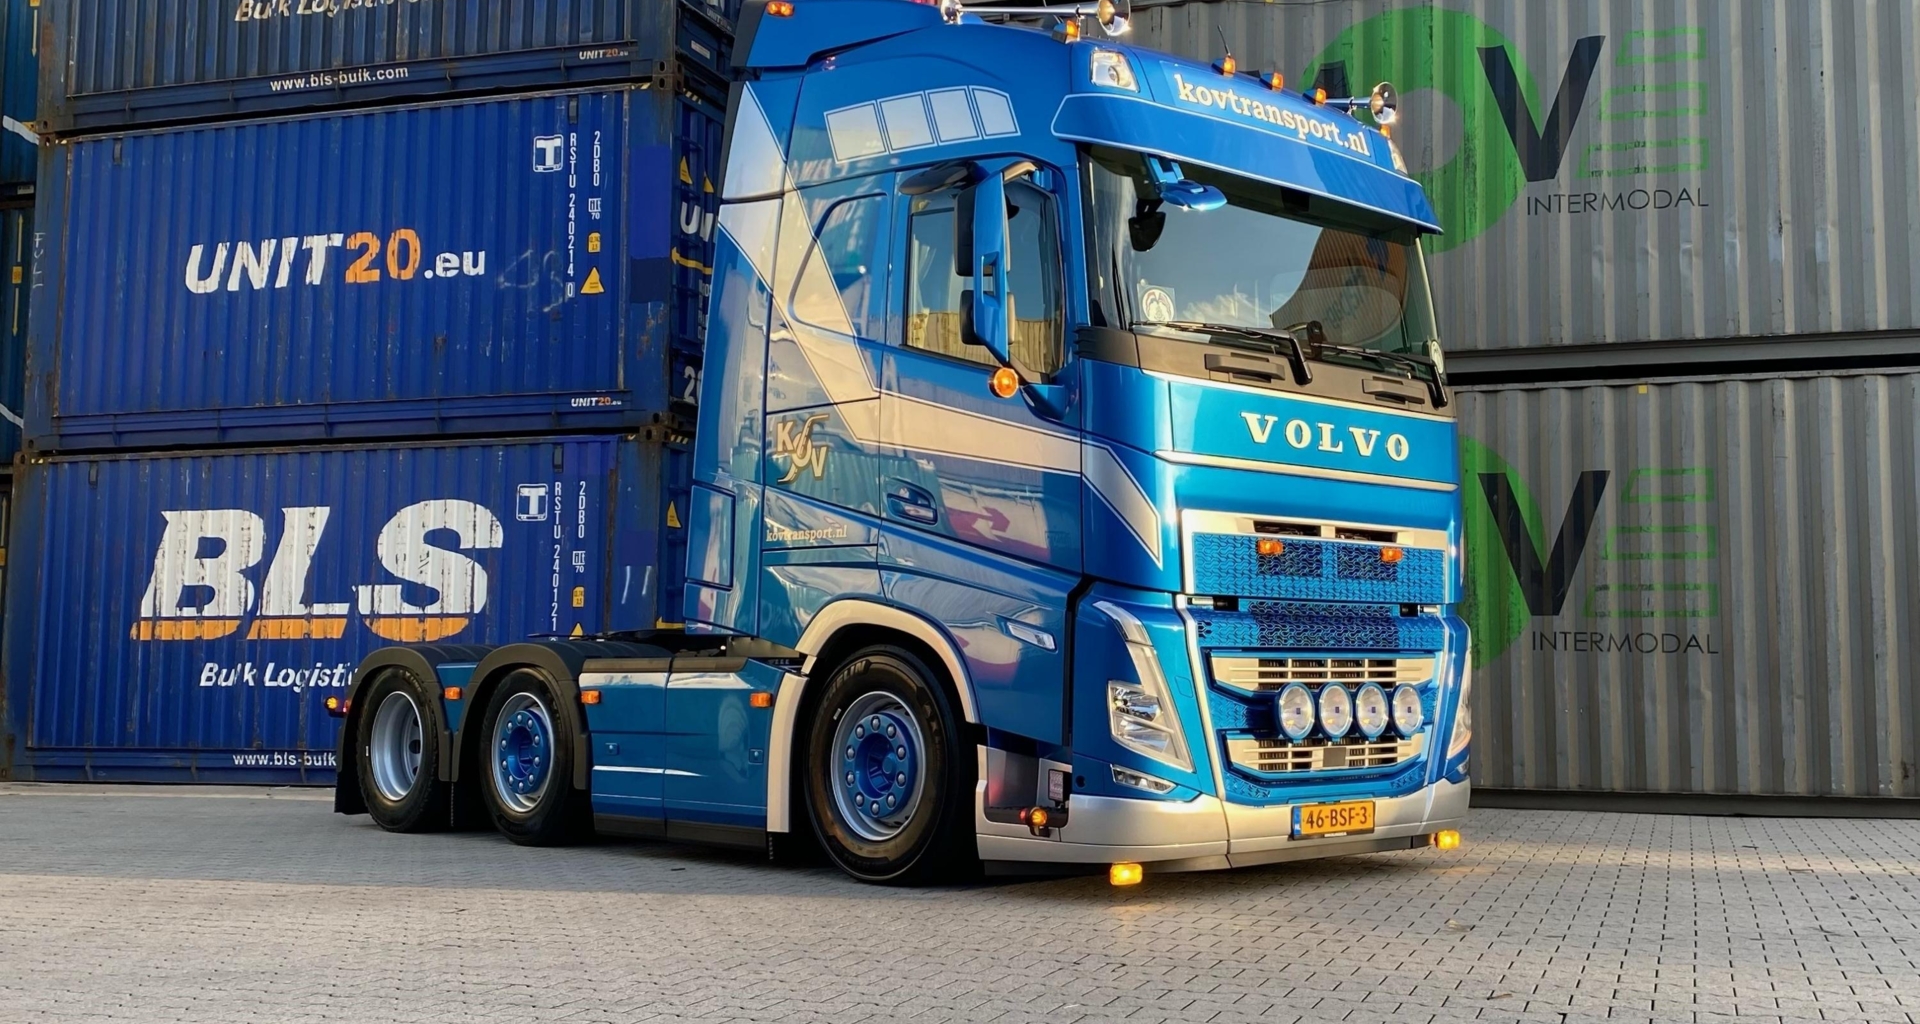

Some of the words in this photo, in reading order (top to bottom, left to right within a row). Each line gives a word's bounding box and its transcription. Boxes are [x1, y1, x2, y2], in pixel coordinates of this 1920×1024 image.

[579, 48, 629, 60] UNIT20.eu
[270, 66, 409, 91] www.bls-bulk.com
[1174, 73, 1371, 158] kovtransport.nl
[569, 132, 577, 188] RSTU
[1527, 187, 1709, 216] INTERMODAL
[567, 193, 576, 277] 240214
[185, 228, 486, 294] UNIT20.eu
[571, 396, 622, 407] UNIT20.eu
[1240, 411, 1410, 462] VOLVO
[554, 482, 562, 539] RSTU
[766, 524, 847, 542] kovtransport.nl
[130, 498, 504, 643] BLS
[551, 544, 561, 631] 240121
[1531, 630, 1719, 655] INTERMODAL
[199, 662, 257, 687] Bulk
[263, 662, 358, 693] Logisti
[1306, 806, 1367, 829] 46-BSF-3
